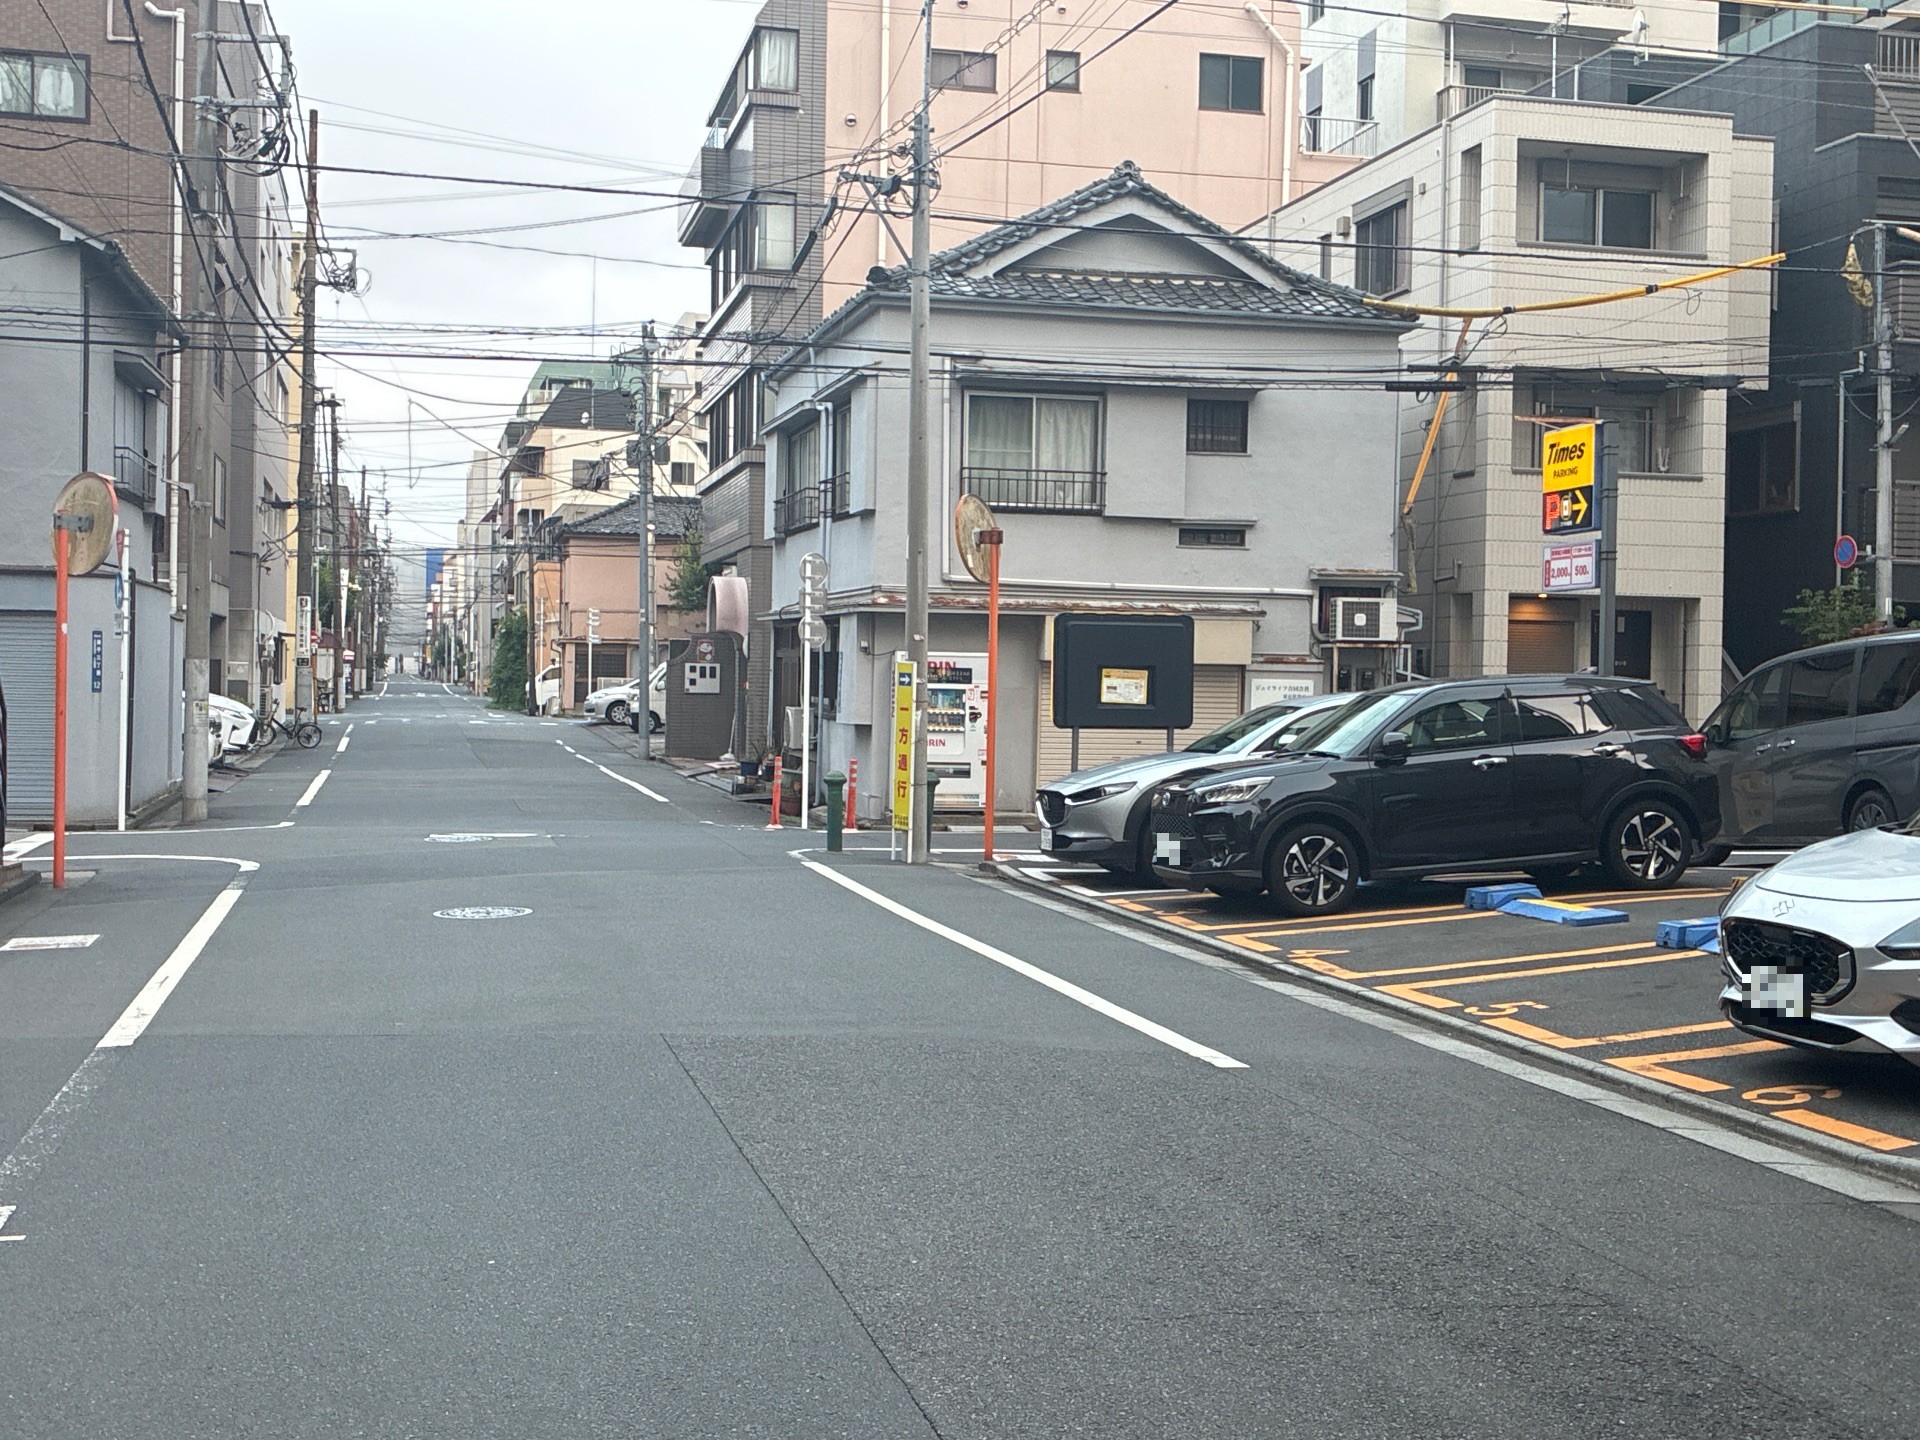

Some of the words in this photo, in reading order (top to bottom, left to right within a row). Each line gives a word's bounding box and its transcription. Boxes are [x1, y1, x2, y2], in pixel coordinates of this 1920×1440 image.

[1547, 441, 1586, 466] Times
[1553, 466, 1579, 479] PARKING
[93, 681, 101, 689] 12
[928, 738, 946, 747] RIN
[897, 707, 909, 799] 一方通行
[1286, 948, 1351, 960] 4
[1463, 1000, 1550, 1018] 5
[1741, 1084, 1842, 1106] 6
